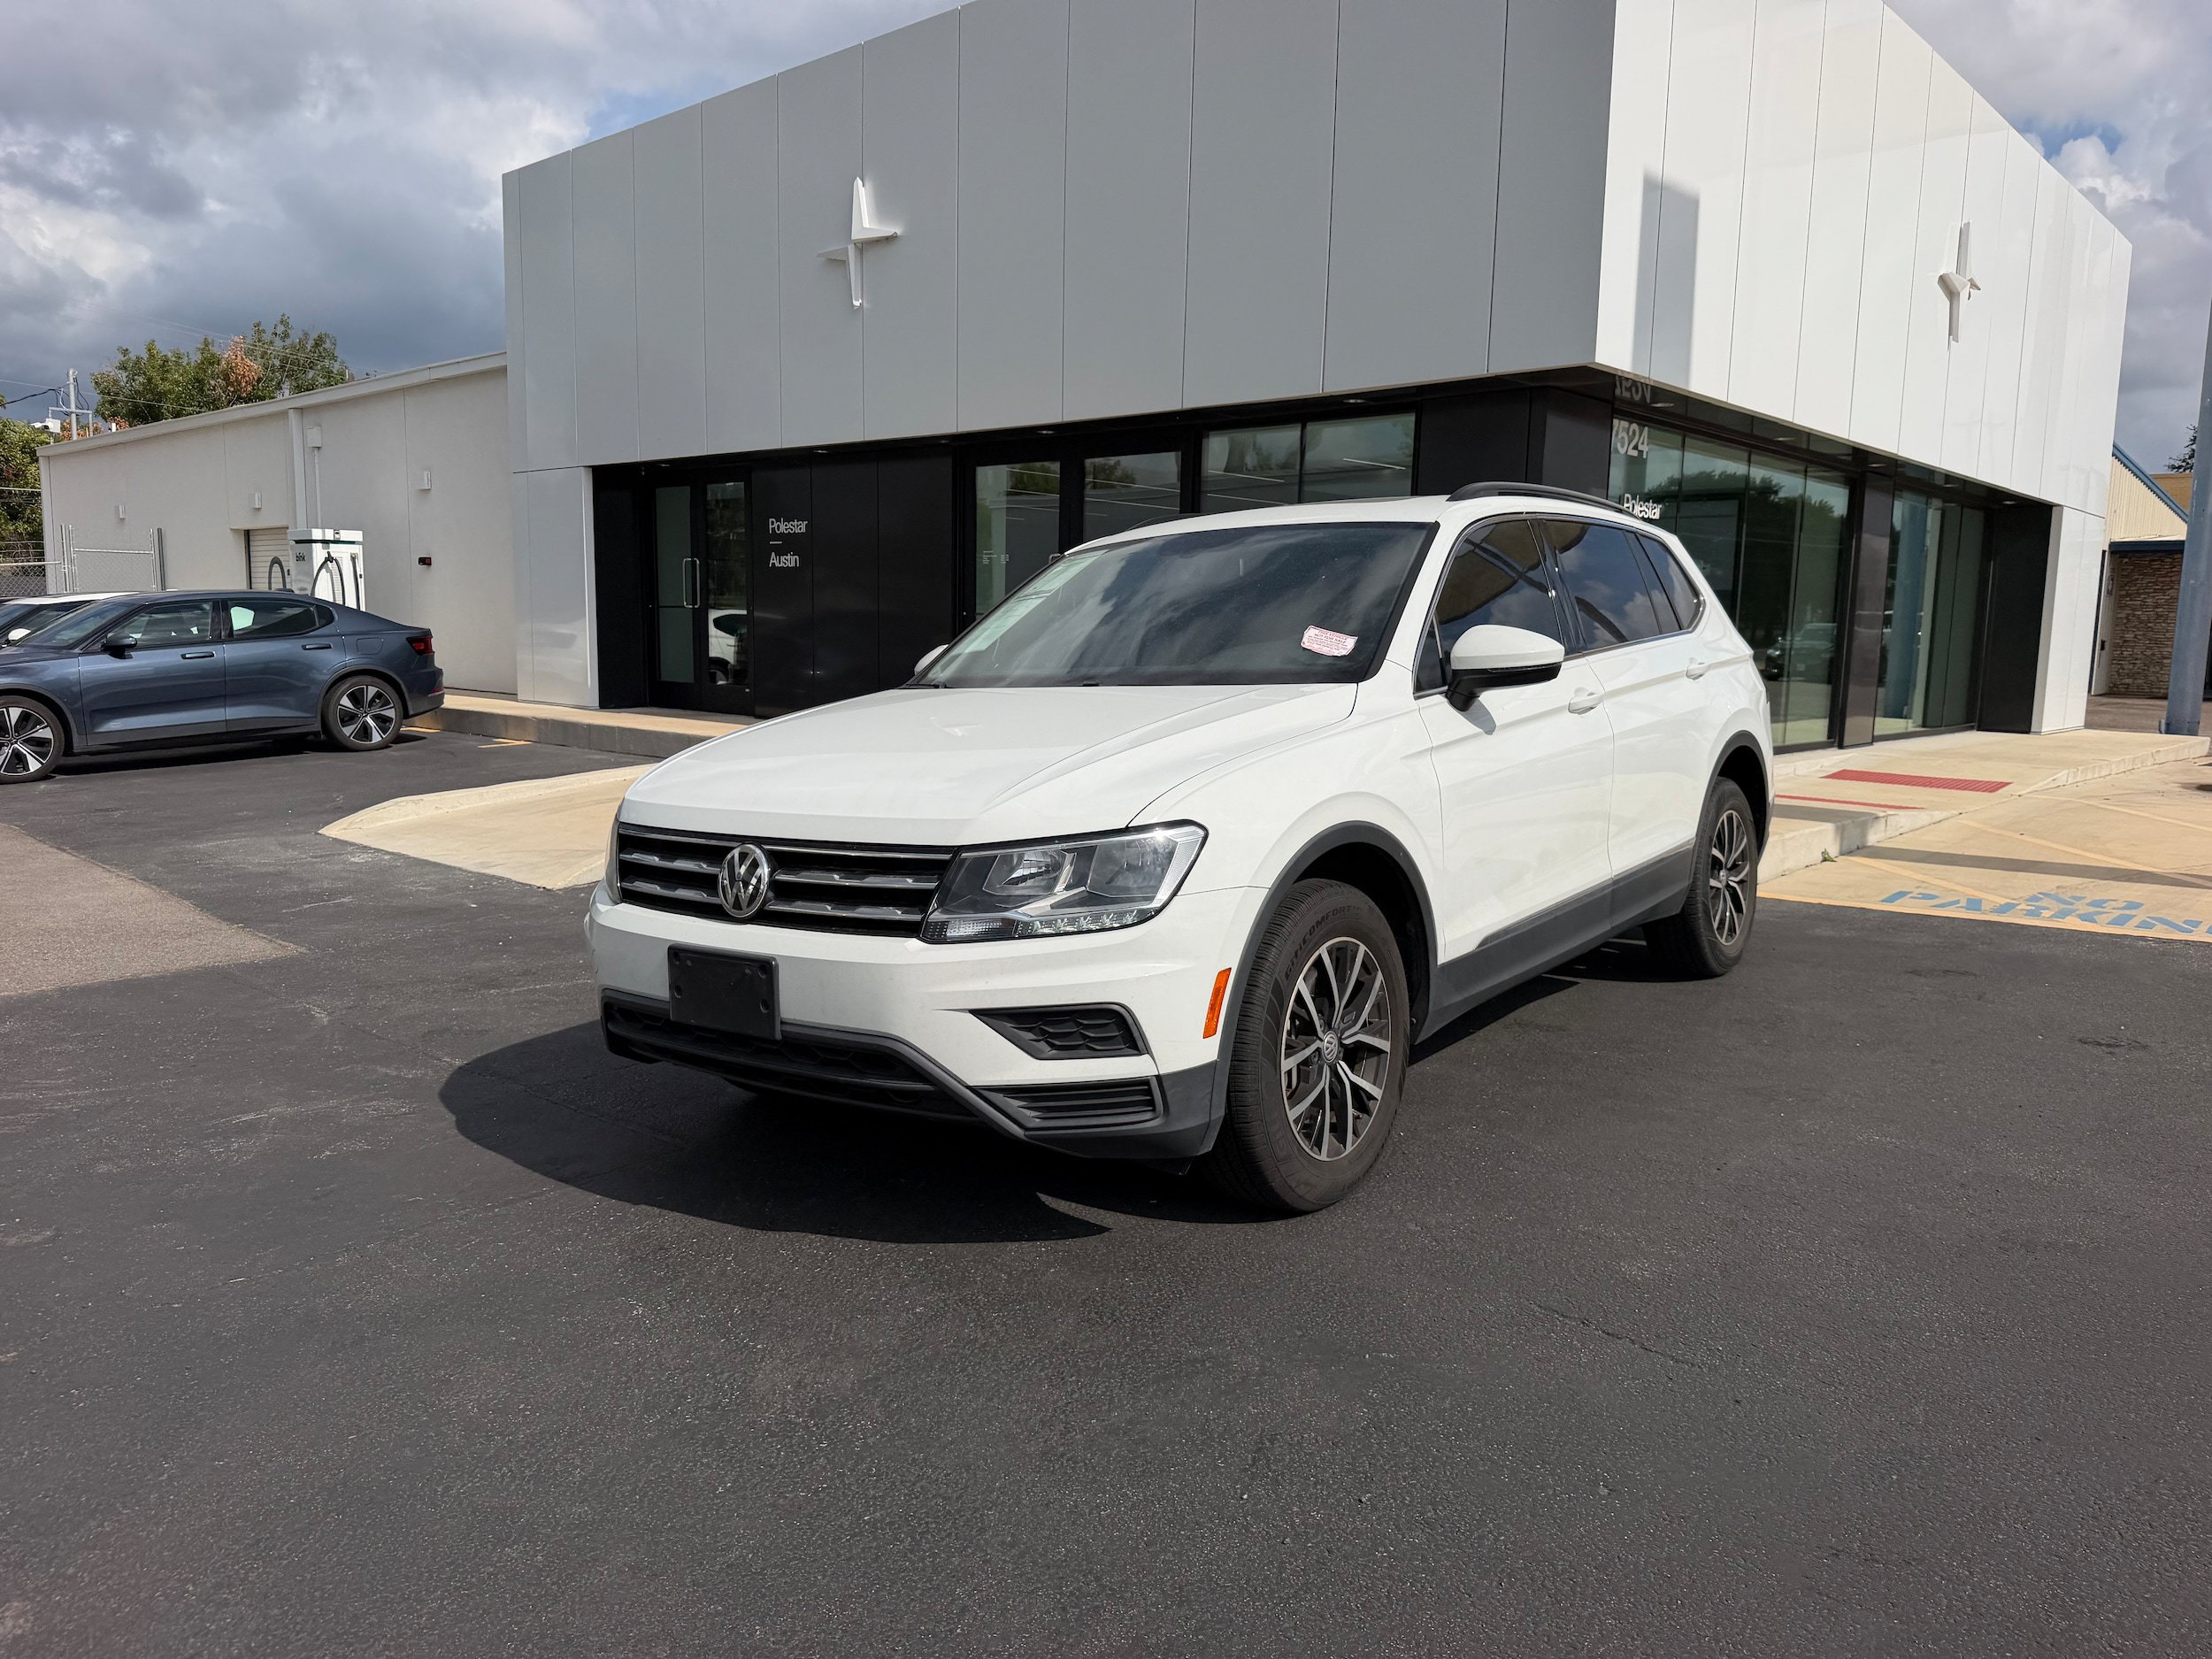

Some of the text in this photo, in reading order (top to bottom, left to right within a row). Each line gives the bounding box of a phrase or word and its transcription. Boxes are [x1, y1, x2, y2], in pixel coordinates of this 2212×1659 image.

[1624, 493, 1663, 520] Polestar
[769, 517, 809, 534] Polestar
[769, 551, 800, 568] Austin
[2024, 891, 2145, 911] NO
[1880, 890, 2212, 934] PARKIN
